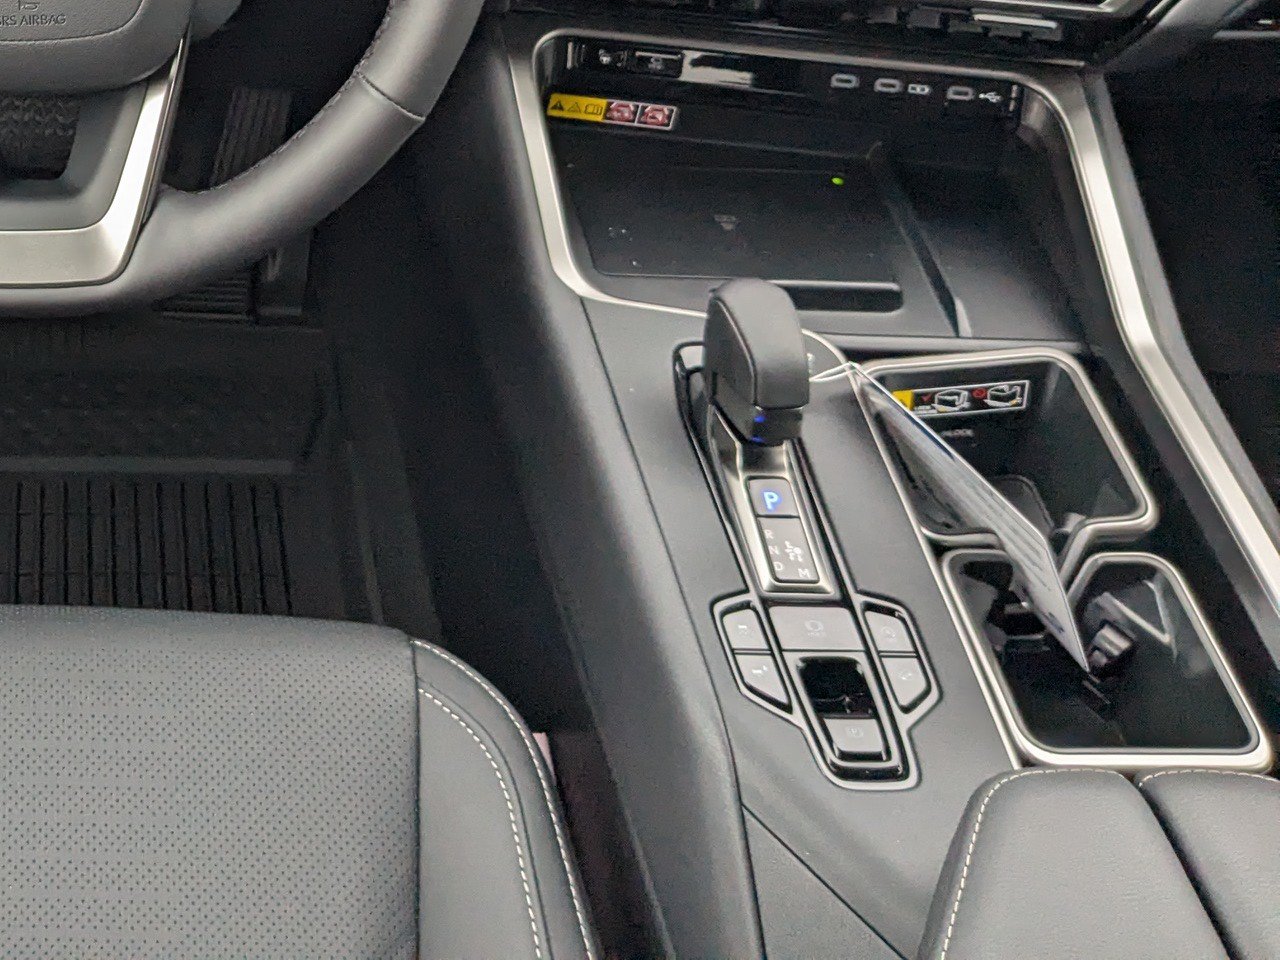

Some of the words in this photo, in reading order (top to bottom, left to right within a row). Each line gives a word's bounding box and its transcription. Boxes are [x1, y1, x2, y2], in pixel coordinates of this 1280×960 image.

[20, 12, 67, 26] AIRBAG
[763, 491, 780, 511] P
[763, 529, 774, 540] R
[768, 546, 780, 555] N
[774, 562, 784, 571] D
[797, 568, 811, 578] M
